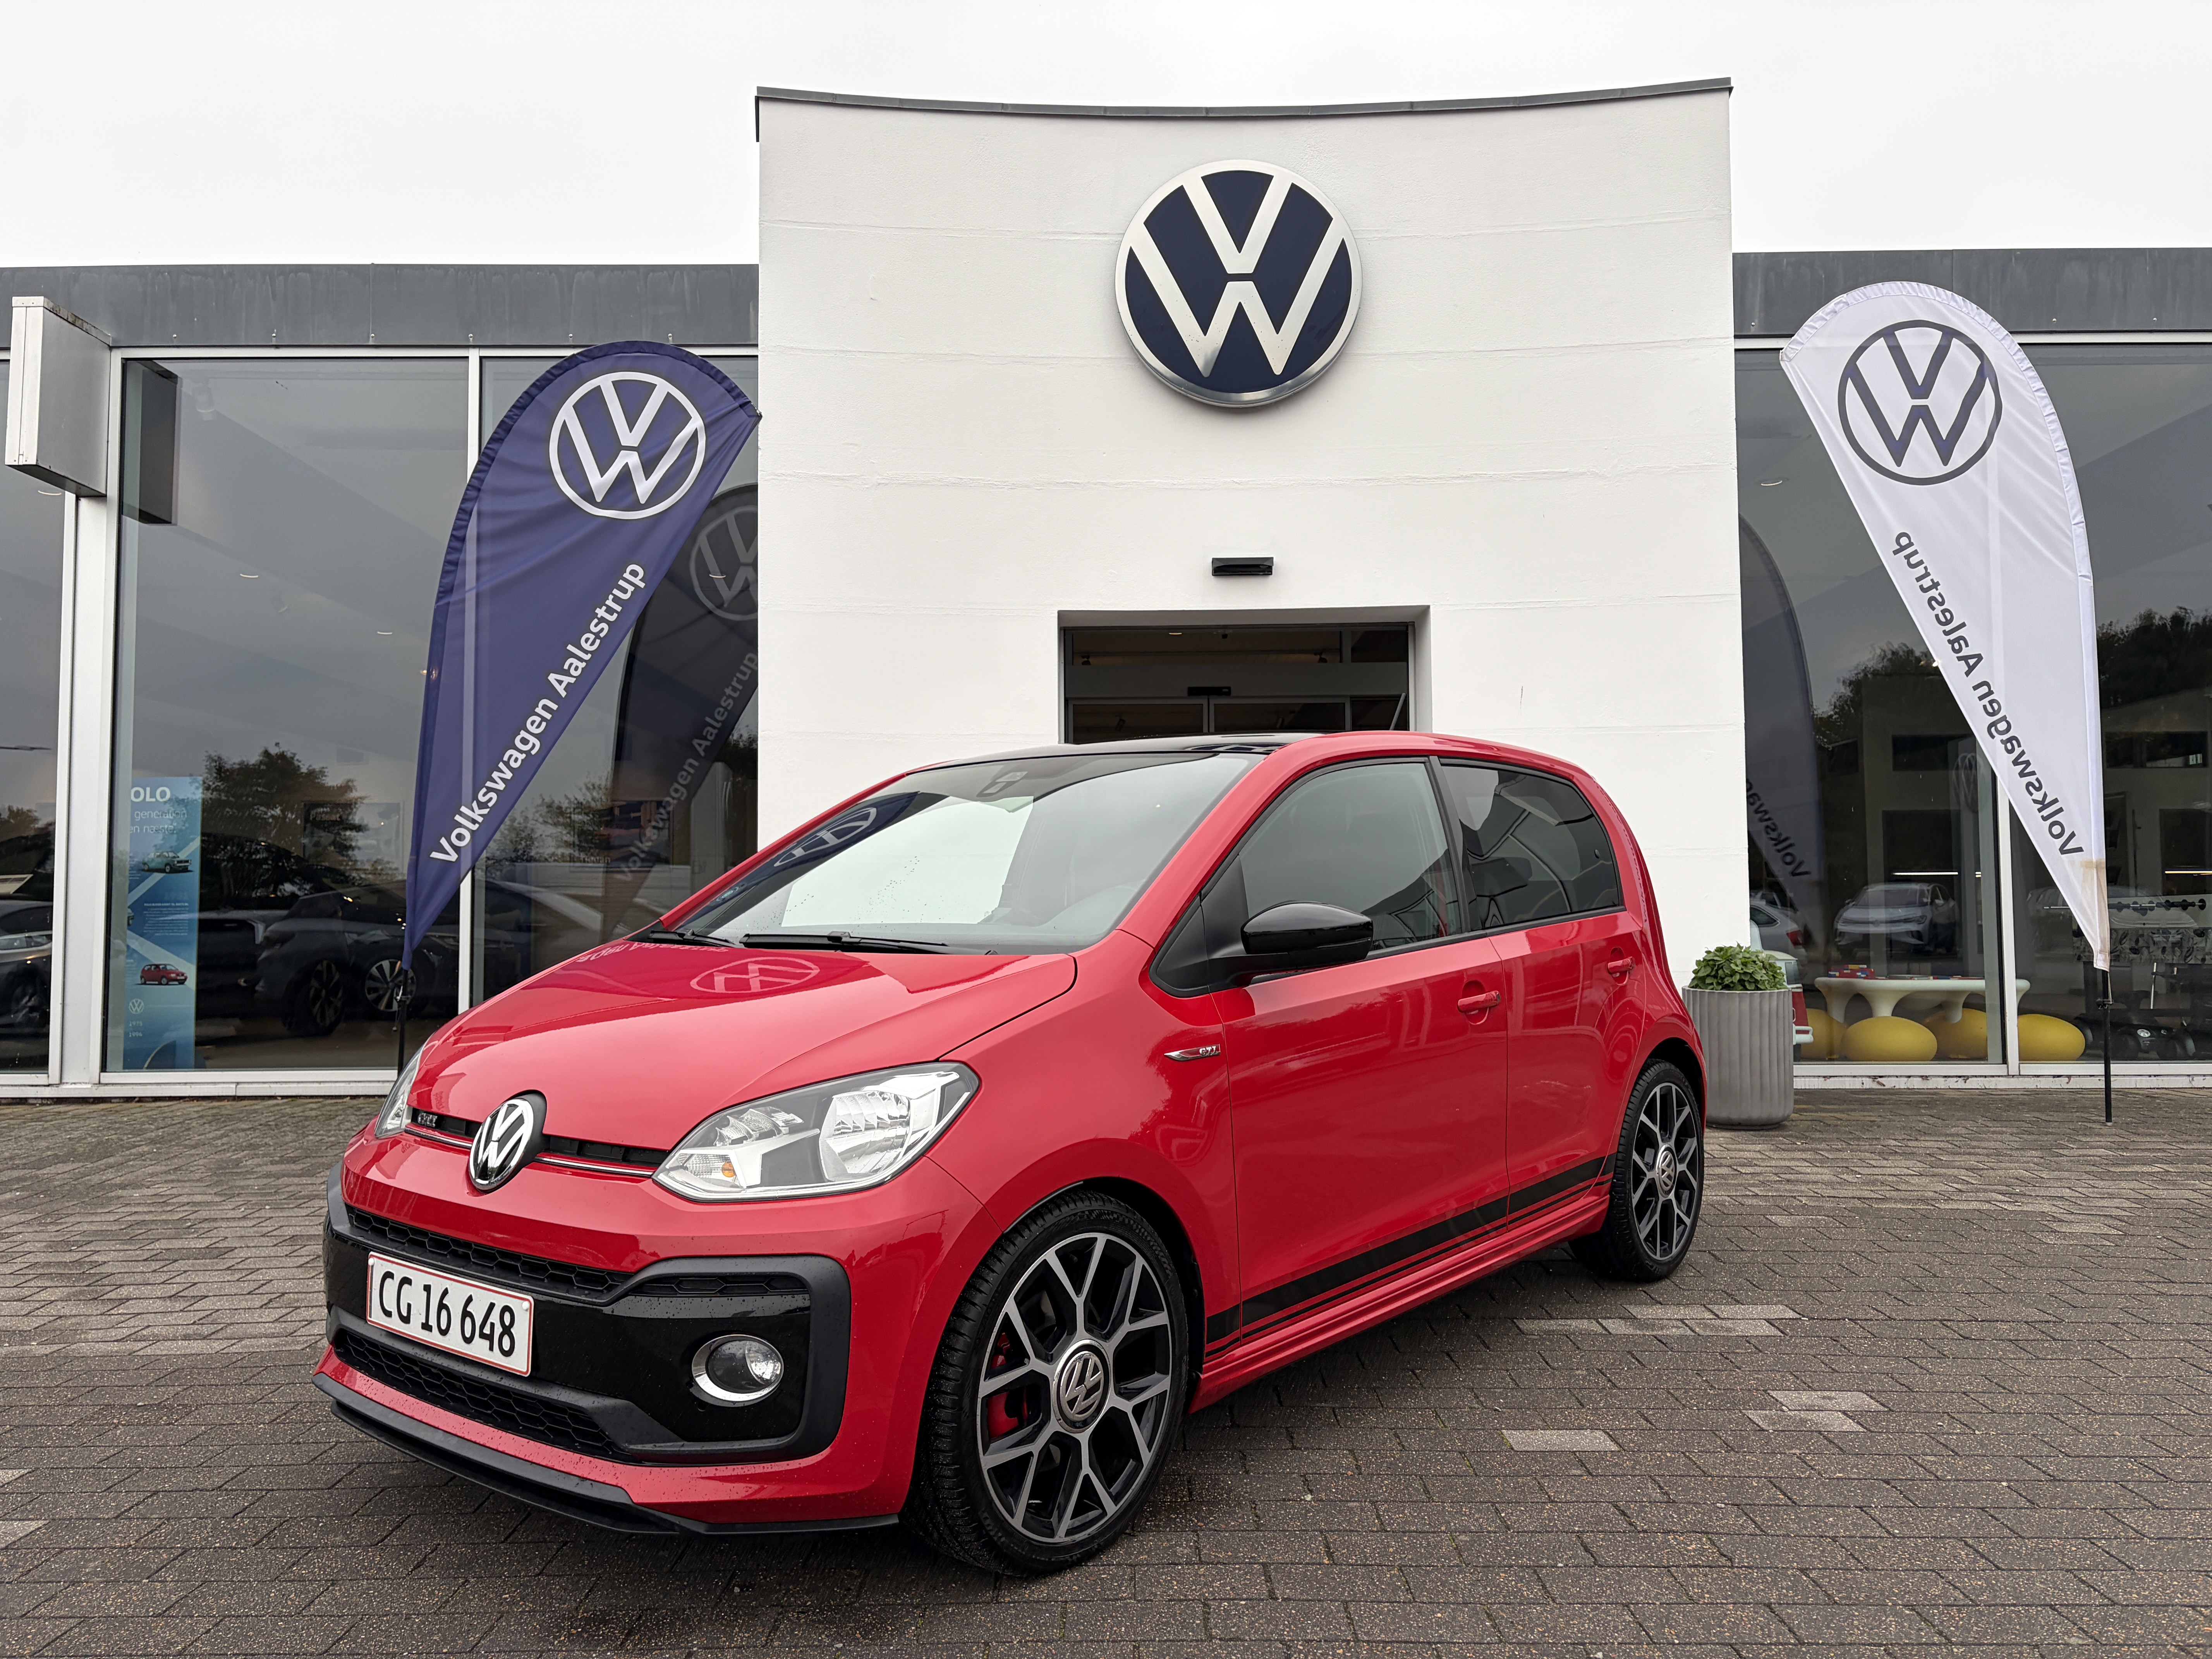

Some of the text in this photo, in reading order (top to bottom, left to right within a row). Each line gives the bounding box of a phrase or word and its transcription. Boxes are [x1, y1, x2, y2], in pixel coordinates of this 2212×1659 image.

[1115, 159, 1362, 407] VW
[549, 371, 705, 519] VW
[1838, 320, 2002, 486] VW
[429, 563, 646, 866] Volkswagen Aalestrup
[131, 787, 171, 802] OLO
[134, 809, 187, 821] generation
[1199, 1046, 1217, 1056] GTI
[469, 1098, 534, 1190] VW
[379, 1271, 515, 1357] CG 16 648
